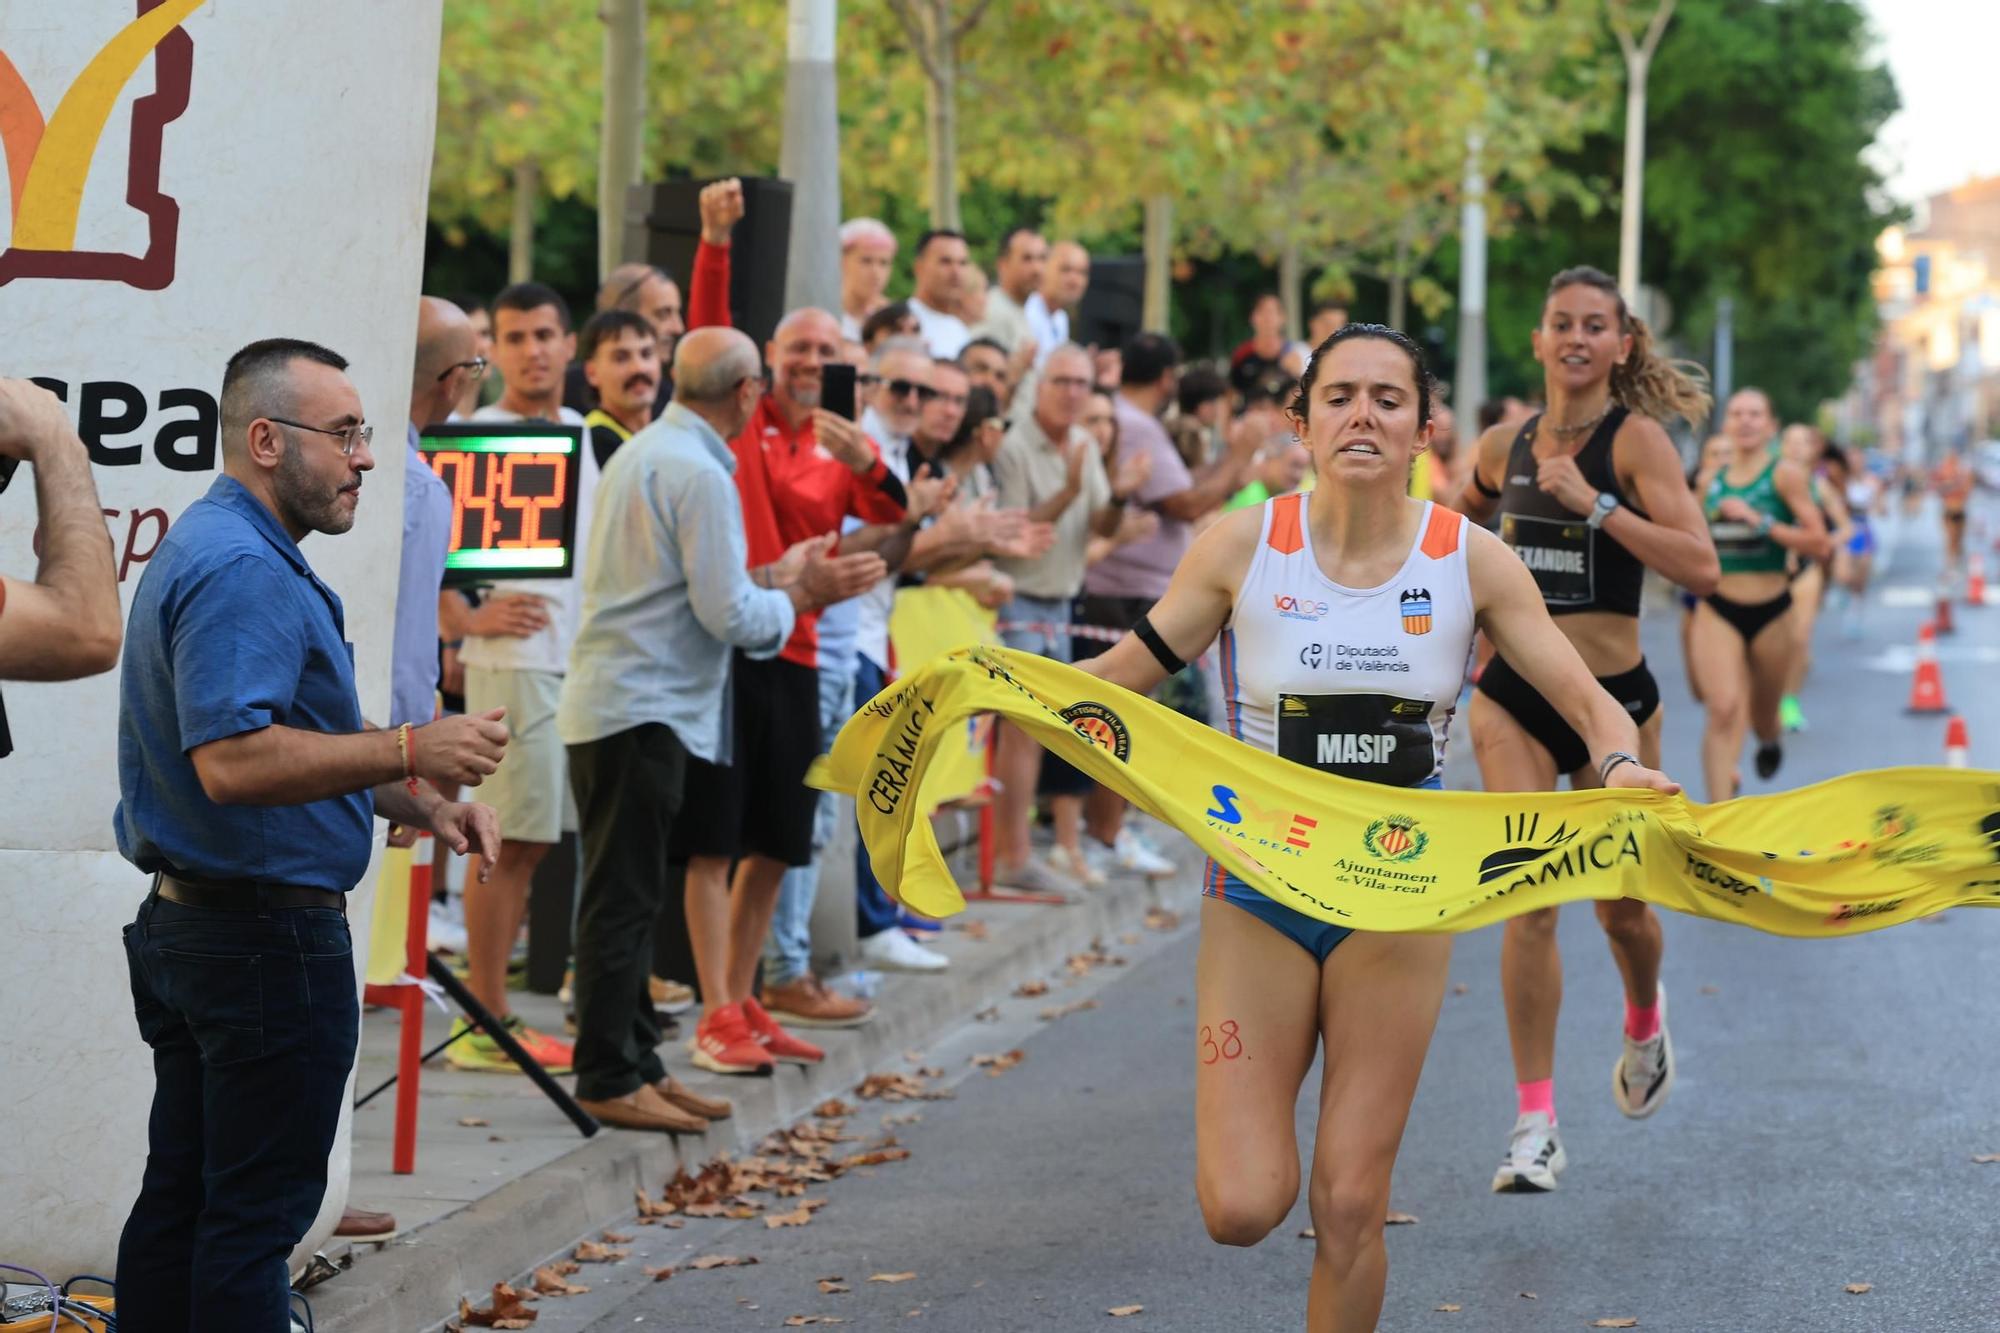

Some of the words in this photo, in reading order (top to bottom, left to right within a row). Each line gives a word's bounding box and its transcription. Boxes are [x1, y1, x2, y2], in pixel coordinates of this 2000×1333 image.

[1515, 545, 1585, 574] EXANDRE
[1336, 645, 1399, 658] Diputació
[1335, 660, 1353, 671] de
[1356, 660, 1410, 672] València
[1062, 706, 1104, 720] TLETISME
[1317, 734, 1397, 764] MASIP
[1206, 819, 1303, 858] VILA-REAL
[1333, 858, 1439, 884] Ajuntament
[1335, 875, 1351, 884] de
[1353, 875, 1428, 895] Vila-real
[1200, 1020, 1242, 1065] 38
